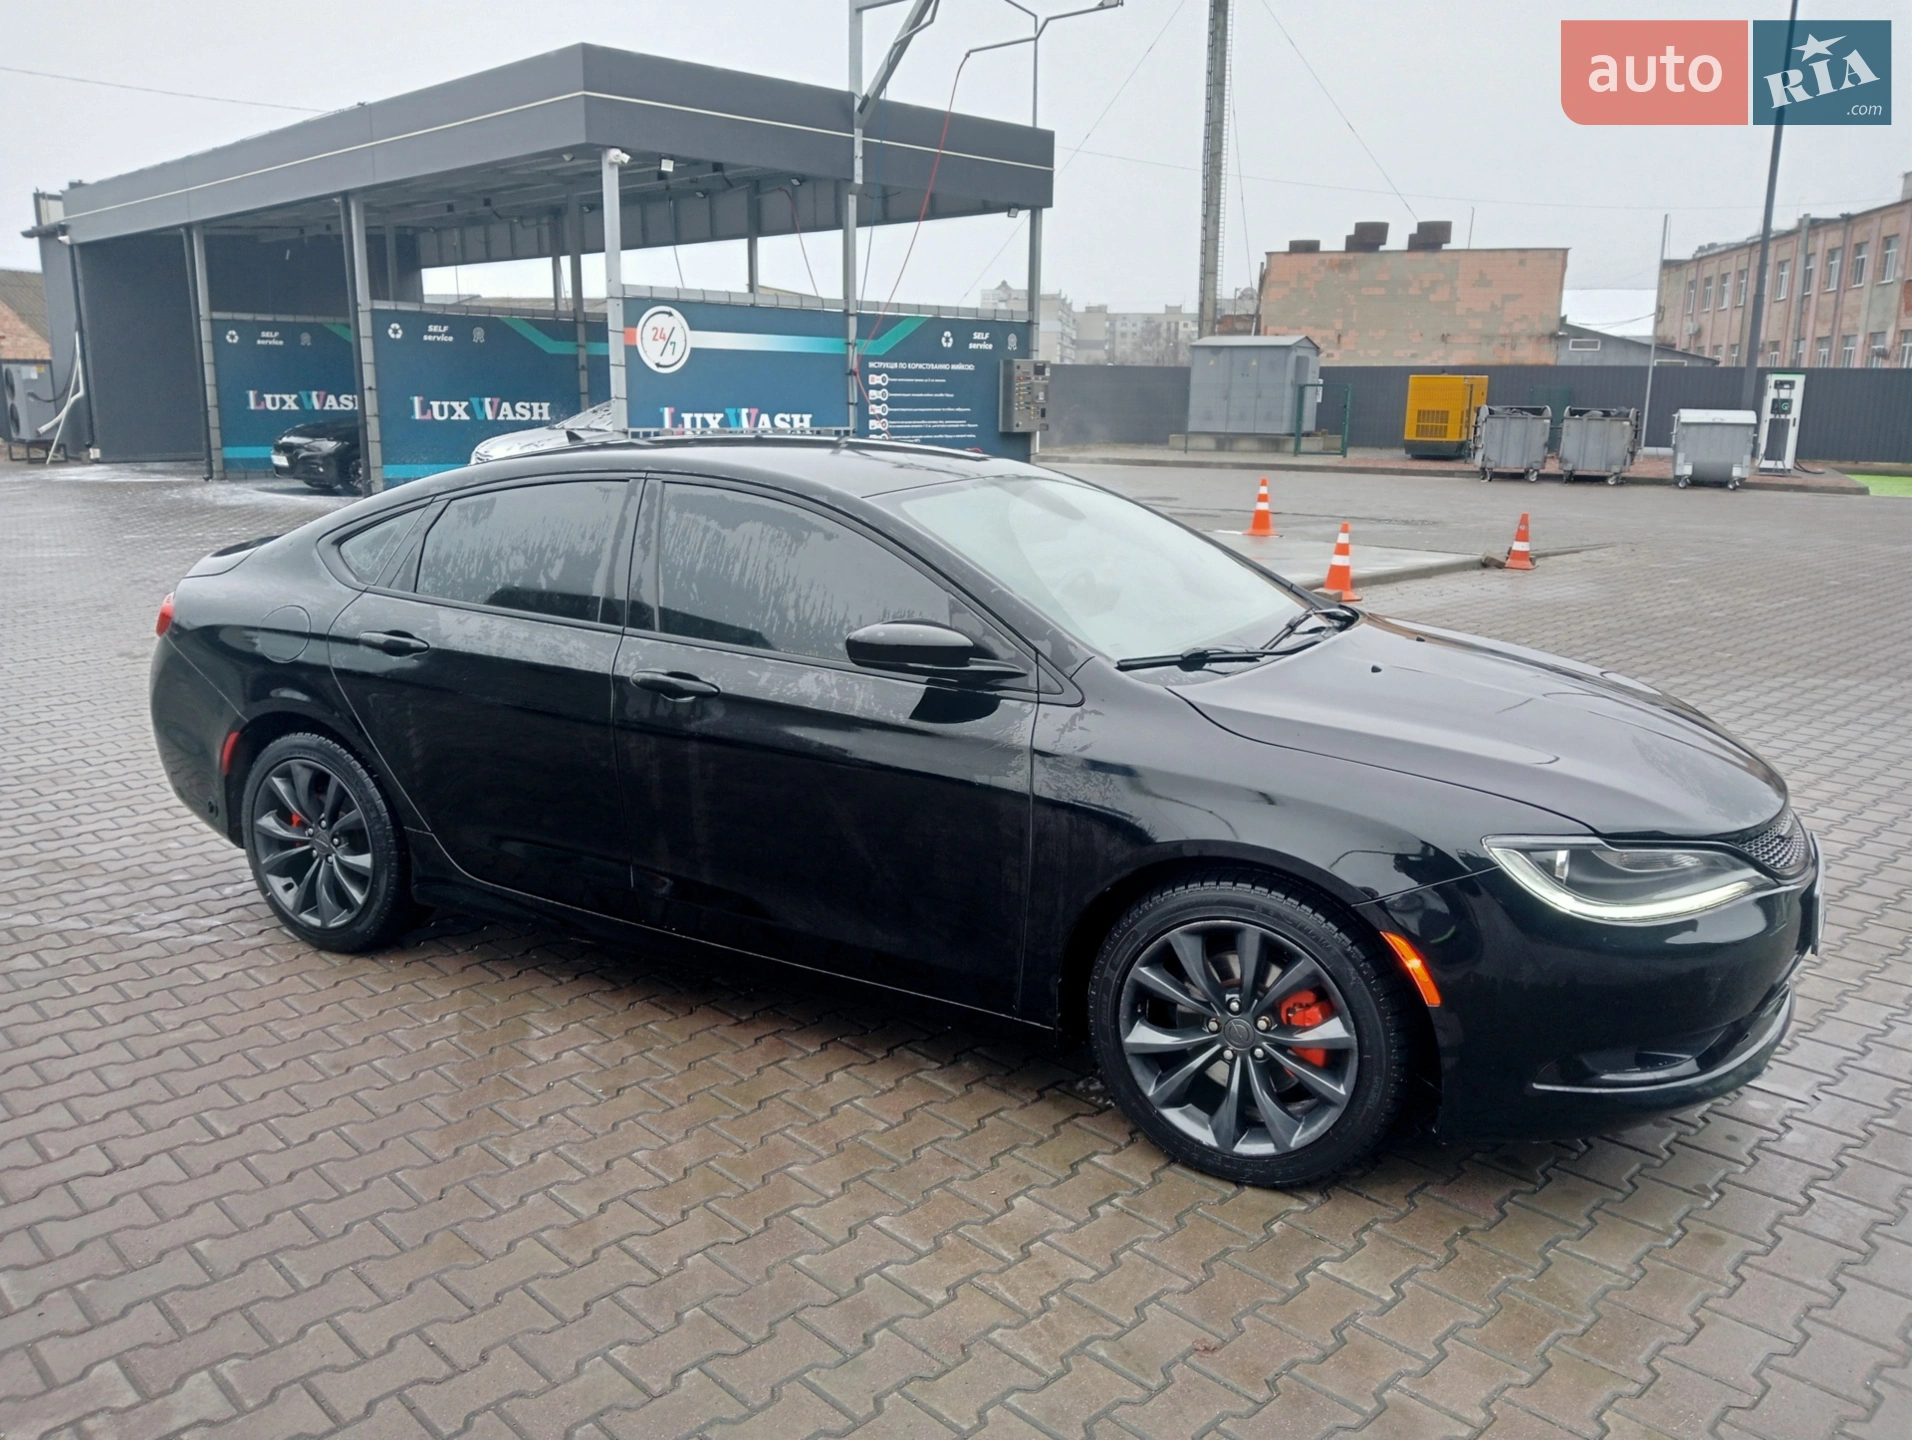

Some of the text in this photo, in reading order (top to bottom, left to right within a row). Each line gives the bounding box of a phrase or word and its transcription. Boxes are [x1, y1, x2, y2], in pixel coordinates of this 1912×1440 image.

[427, 324, 449, 333] SELF
[422, 333, 454, 342] service
[972, 331, 990, 340] SELF
[651, 326, 676, 357] 24/7
[968, 341, 993, 350] service
